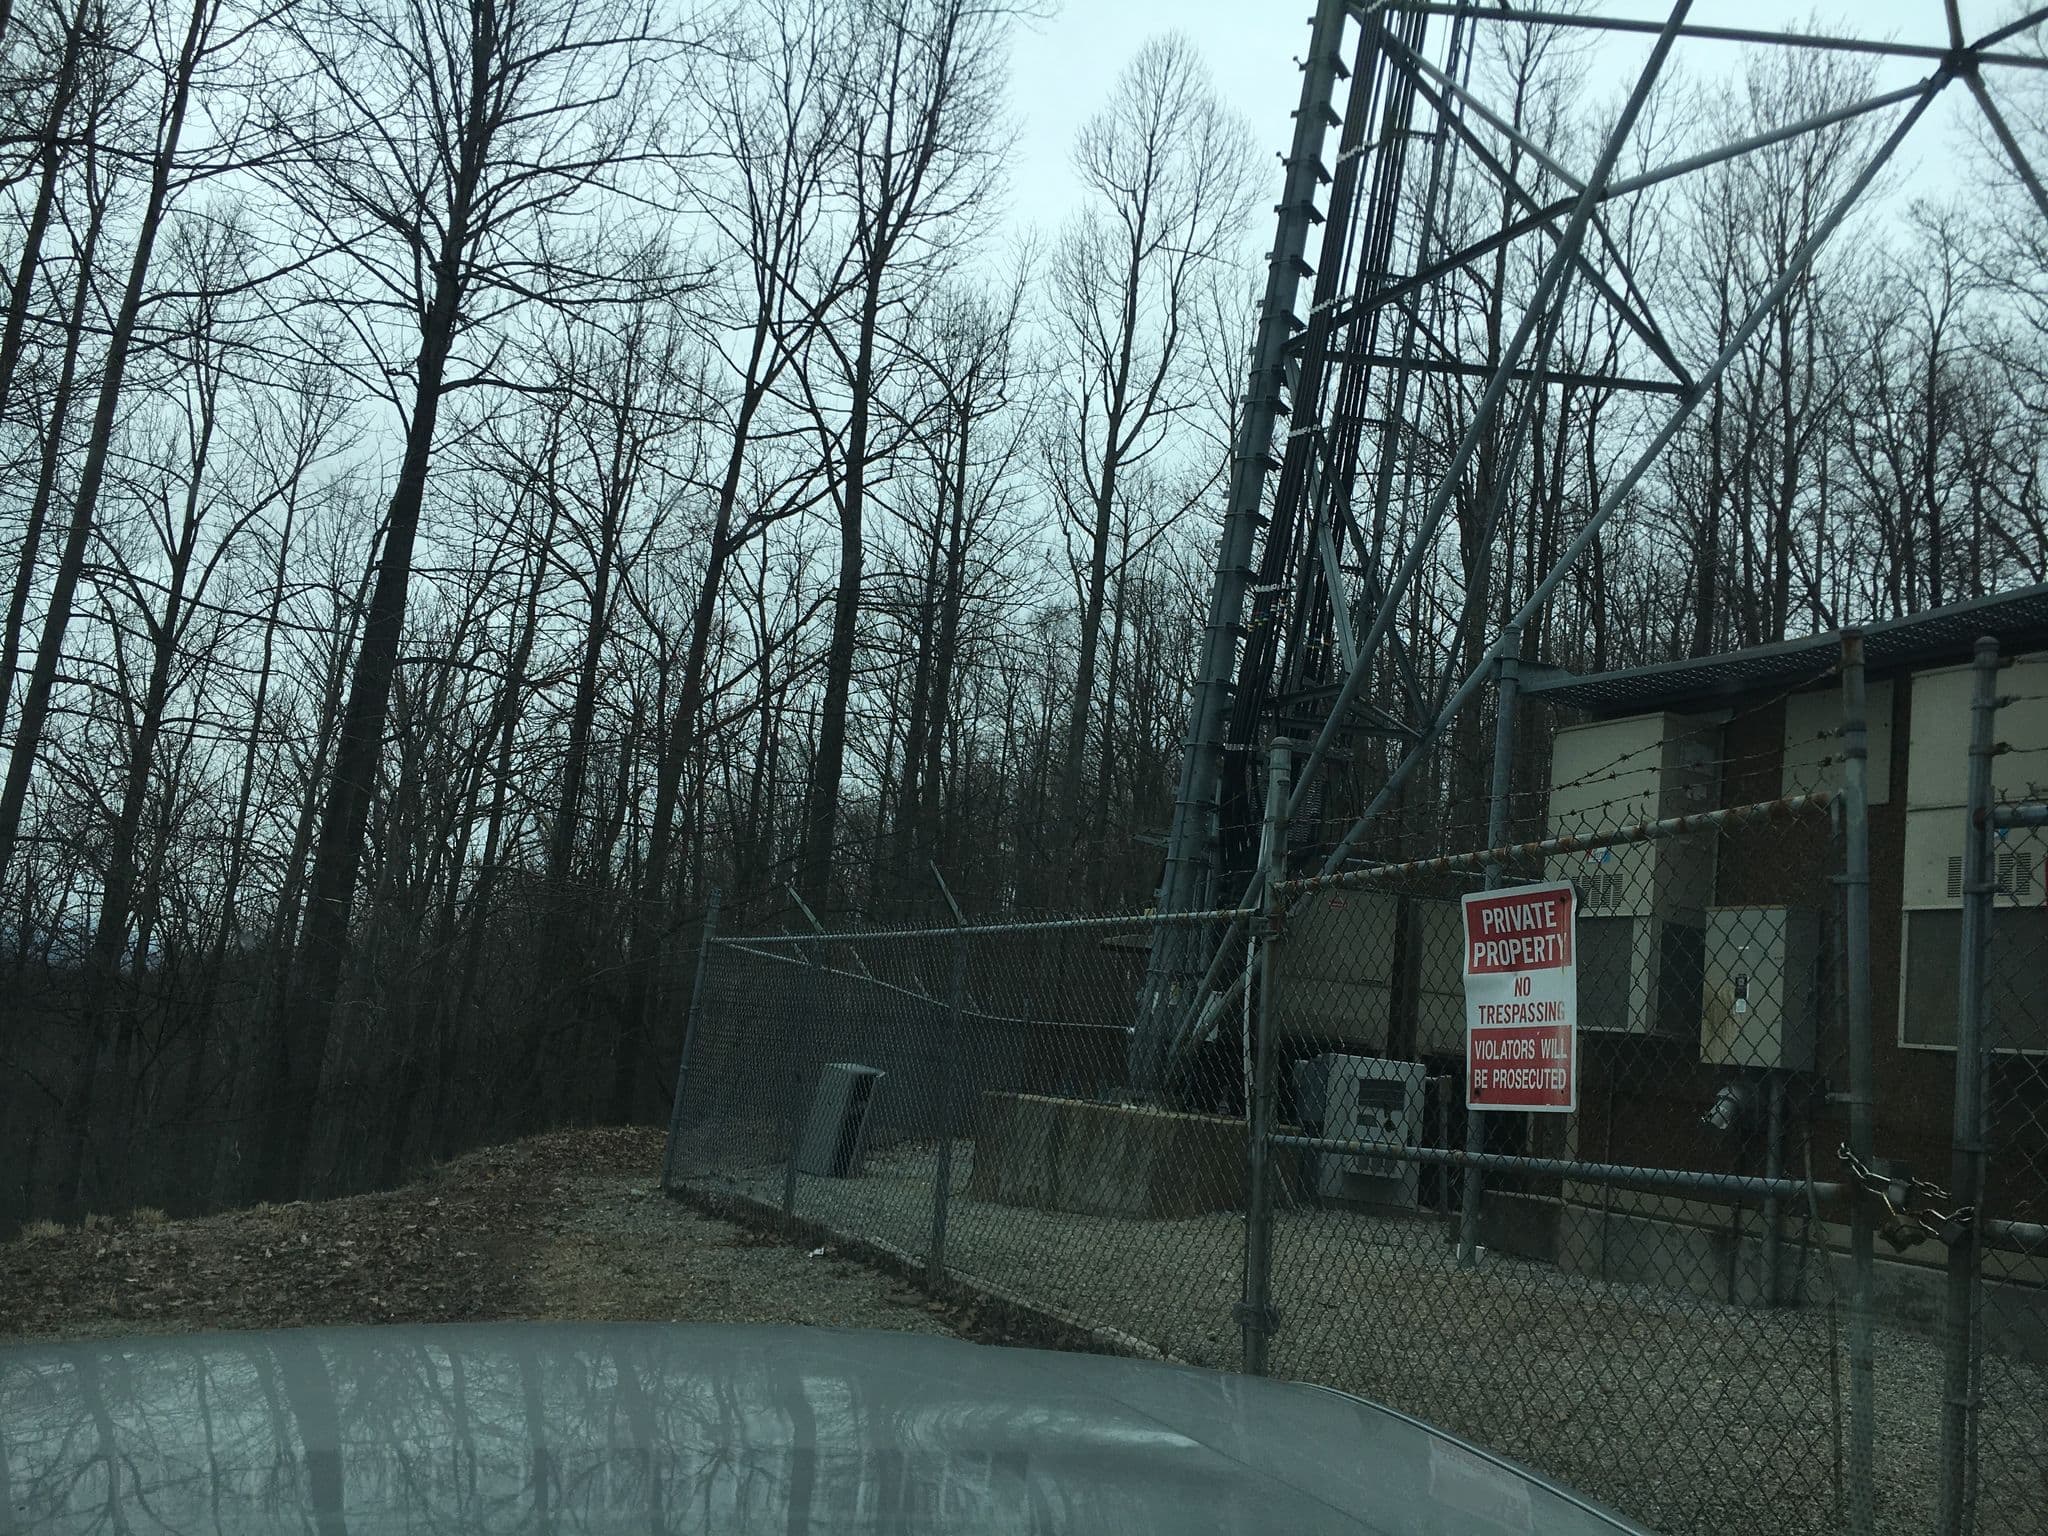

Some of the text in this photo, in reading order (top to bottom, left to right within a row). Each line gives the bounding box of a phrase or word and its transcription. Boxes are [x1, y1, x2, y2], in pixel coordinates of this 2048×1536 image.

[1482, 900, 1557, 935] PRIVATE
[1473, 932, 1568, 968] PROPERTY
[1514, 976, 1531, 997] NO
[1478, 1001, 1565, 1025] TRESPASSING
[1474, 1038, 1568, 1061] VIOLATORS WILL
[1474, 1068, 1567, 1091] BE PROSECUTED
